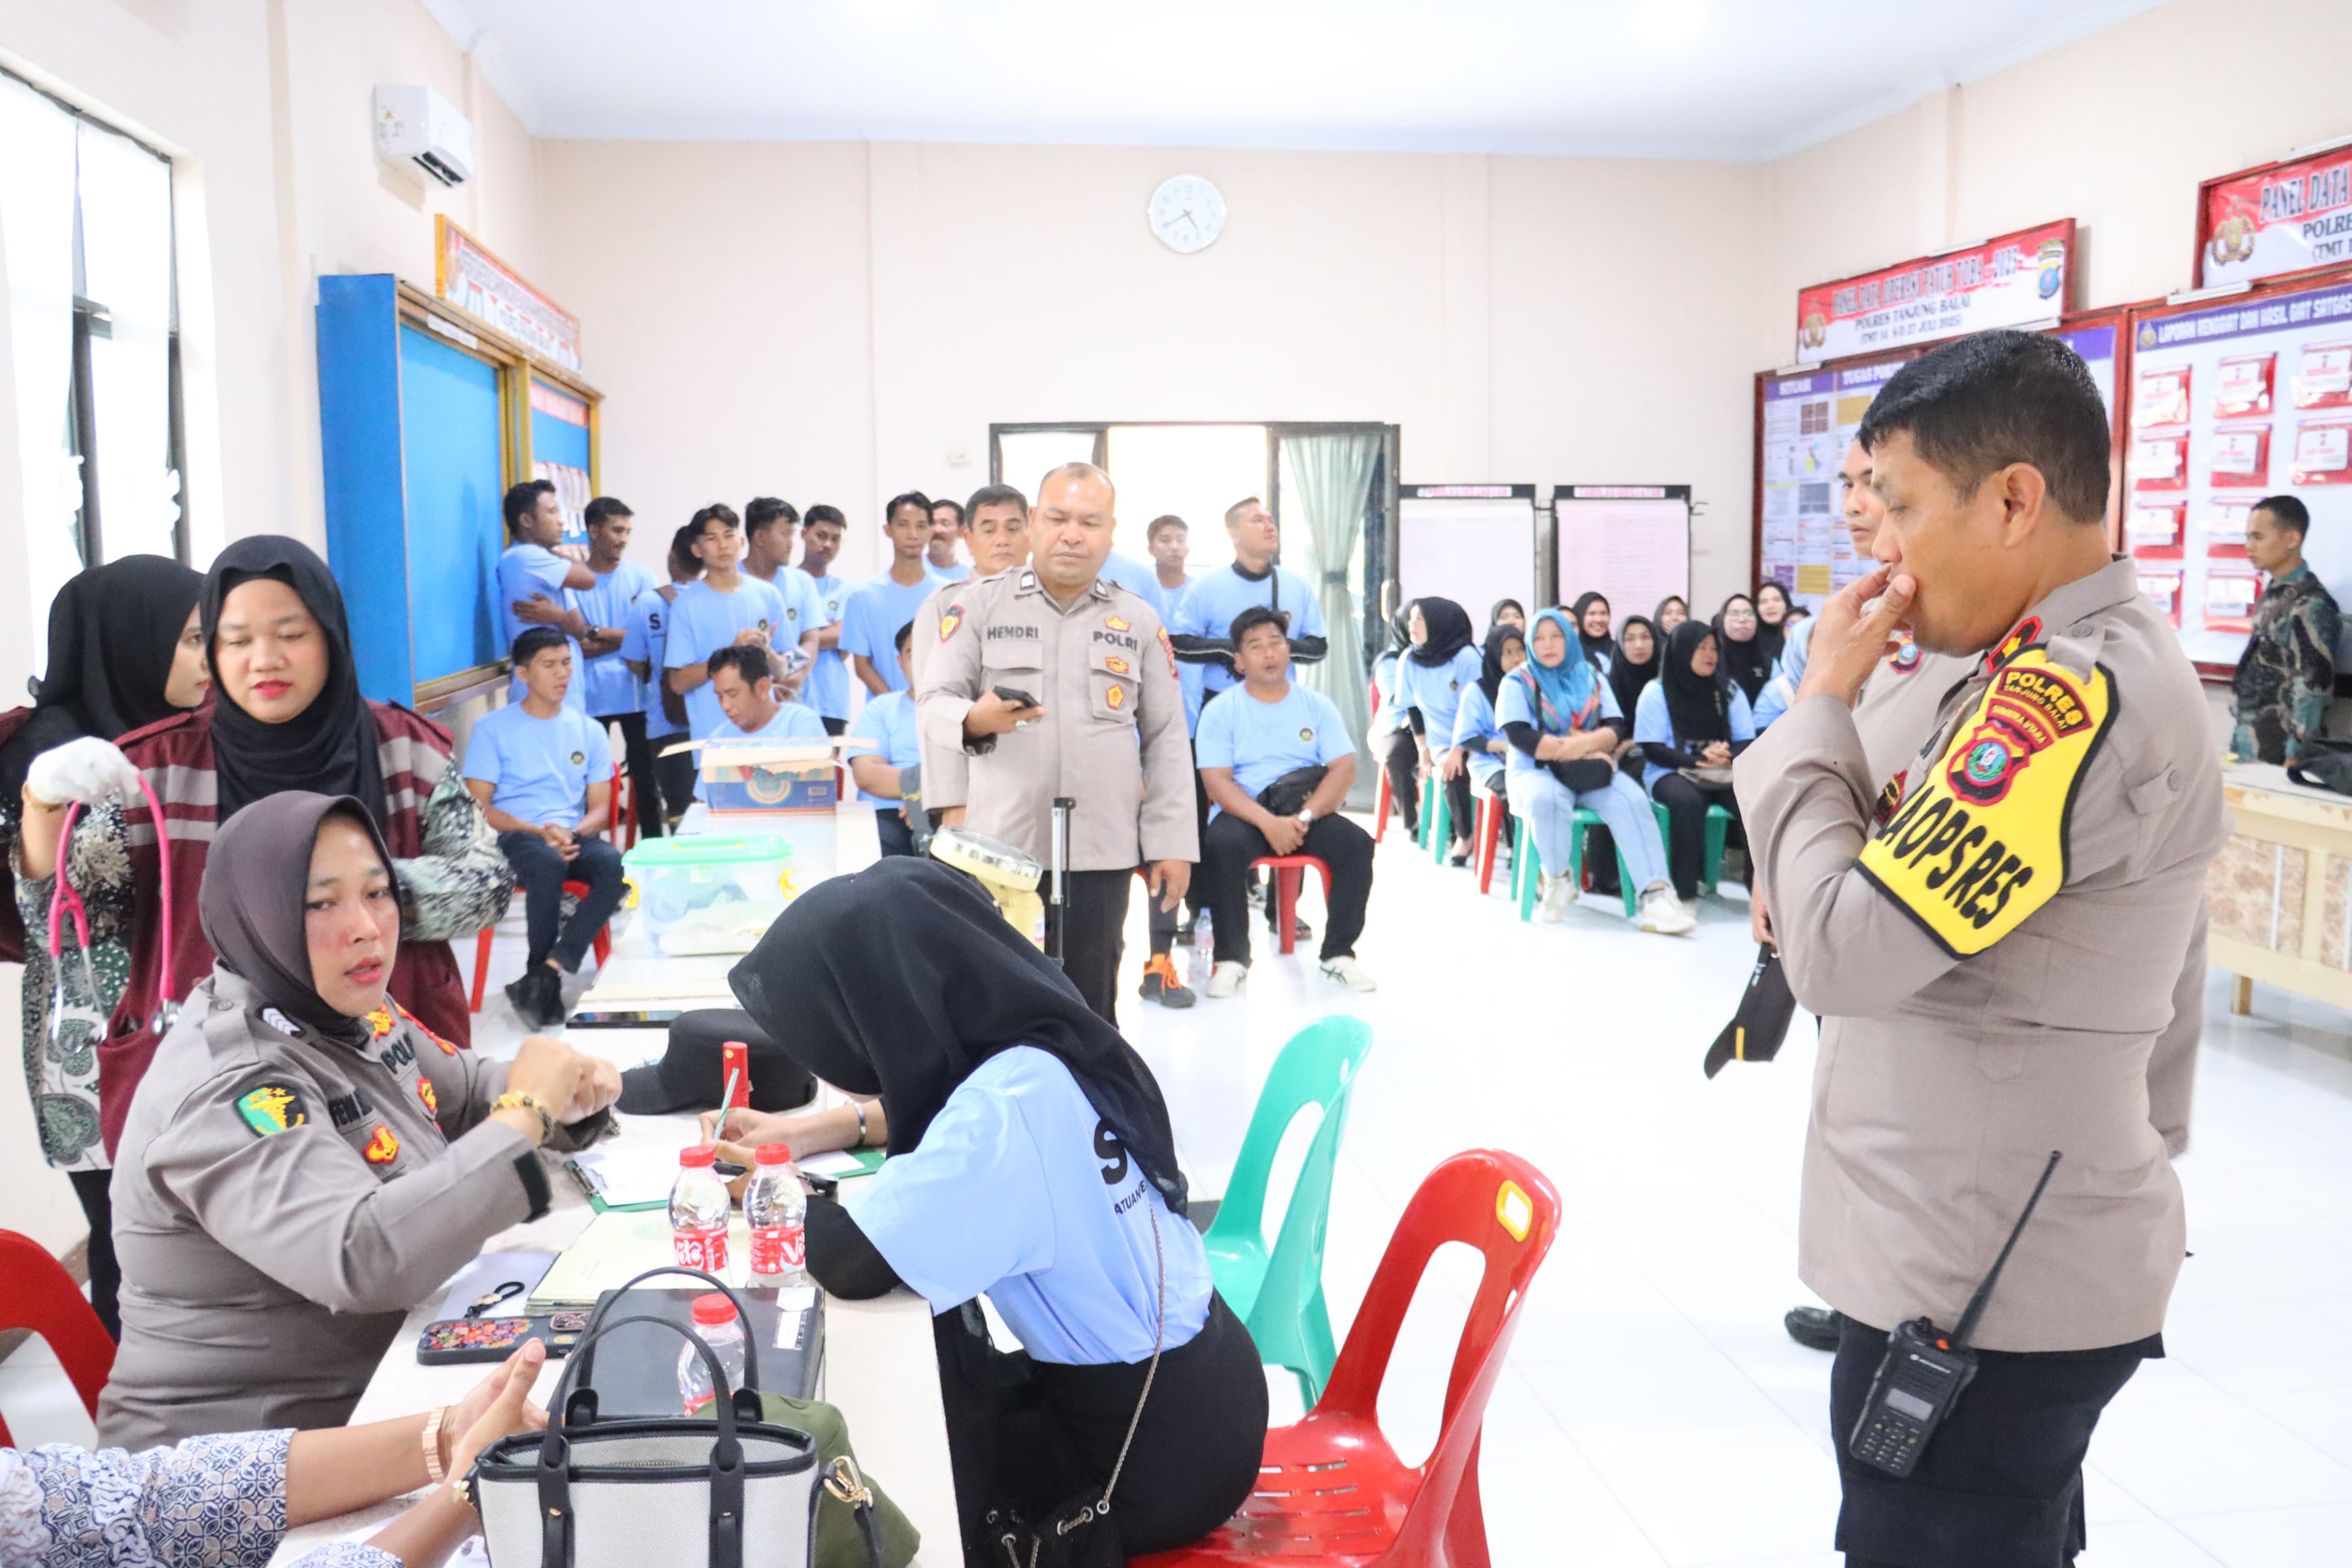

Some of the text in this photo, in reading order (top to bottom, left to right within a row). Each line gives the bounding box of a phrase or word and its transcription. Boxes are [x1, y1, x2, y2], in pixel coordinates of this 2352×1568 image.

[2260, 166, 2349, 222] PANEL DATA
[1854, 294, 1971, 331] POLRES TANJUNG BALAI
[987, 626, 1038, 640] HENDRI
[1093, 631, 1137, 651] POLRI
[2005, 671, 2084, 726] POLRES
